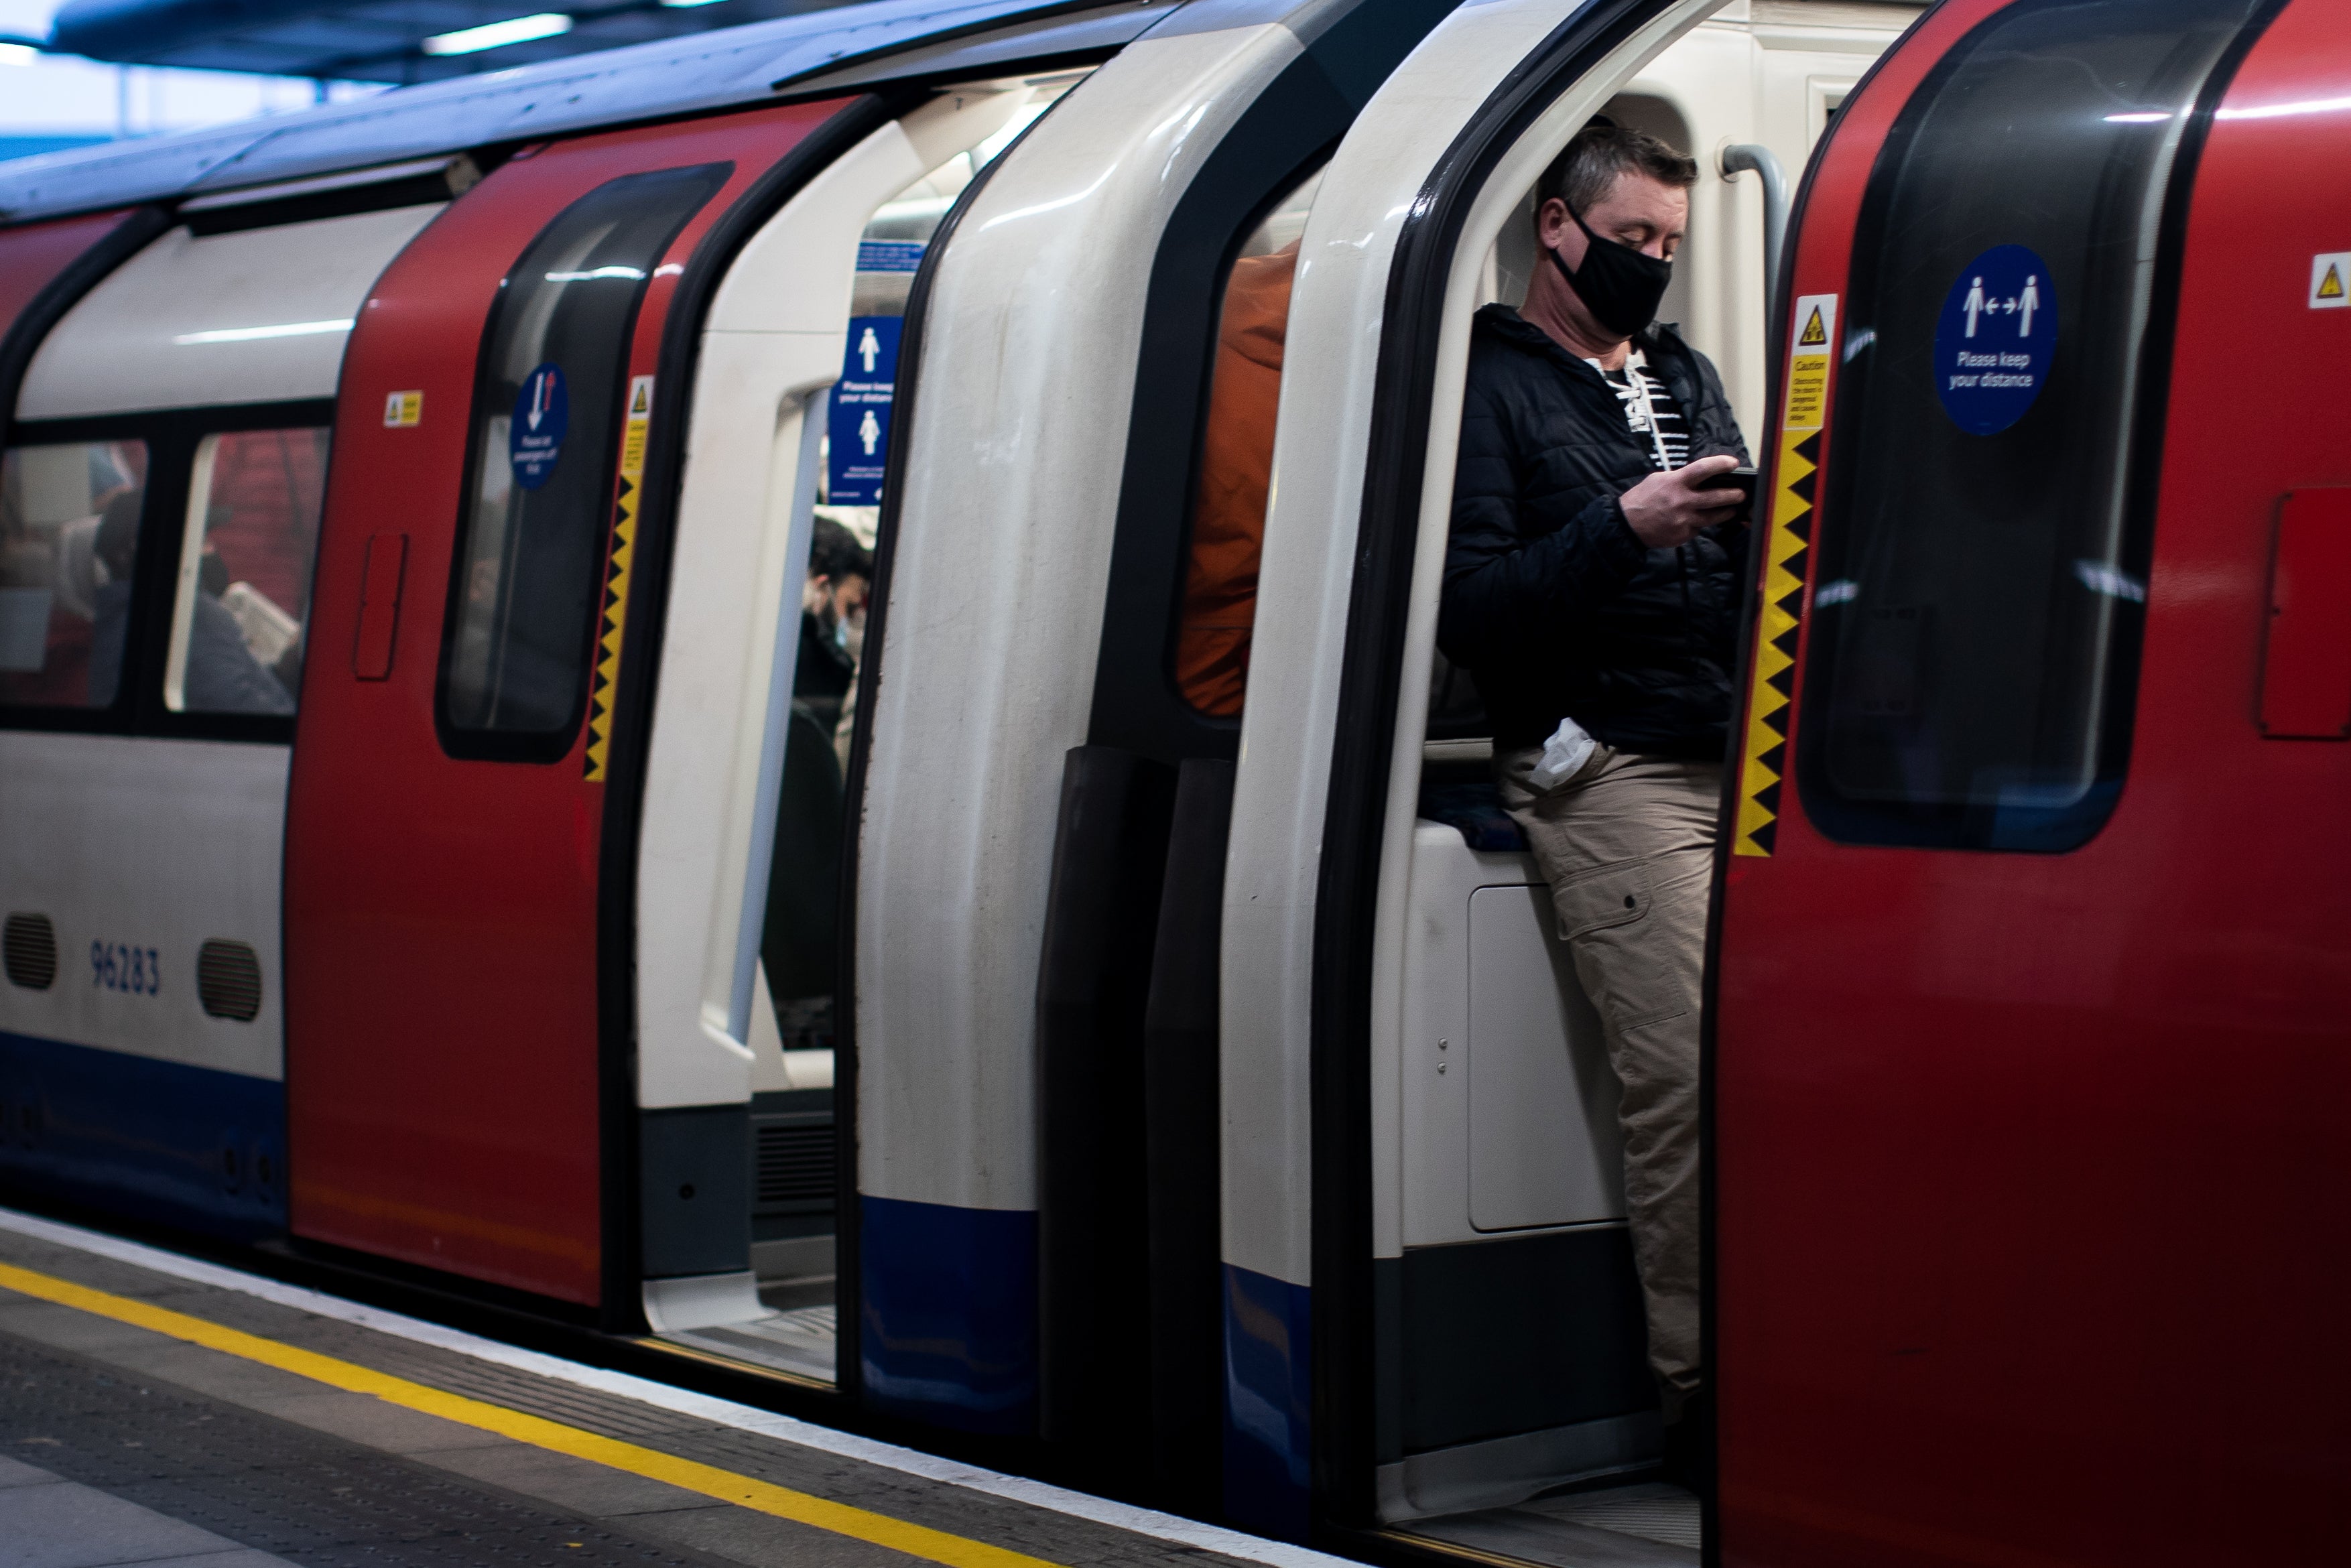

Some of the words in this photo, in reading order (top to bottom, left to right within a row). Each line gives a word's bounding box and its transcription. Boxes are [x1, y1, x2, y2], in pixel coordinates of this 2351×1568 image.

[1796, 361, 1824, 371] Caution
[1957, 351, 1998, 367] Please
[1999, 351, 2031, 369] keep
[1949, 375, 1979, 390] your
[1980, 372, 2033, 387] distance
[91, 940, 160, 996] 96283
